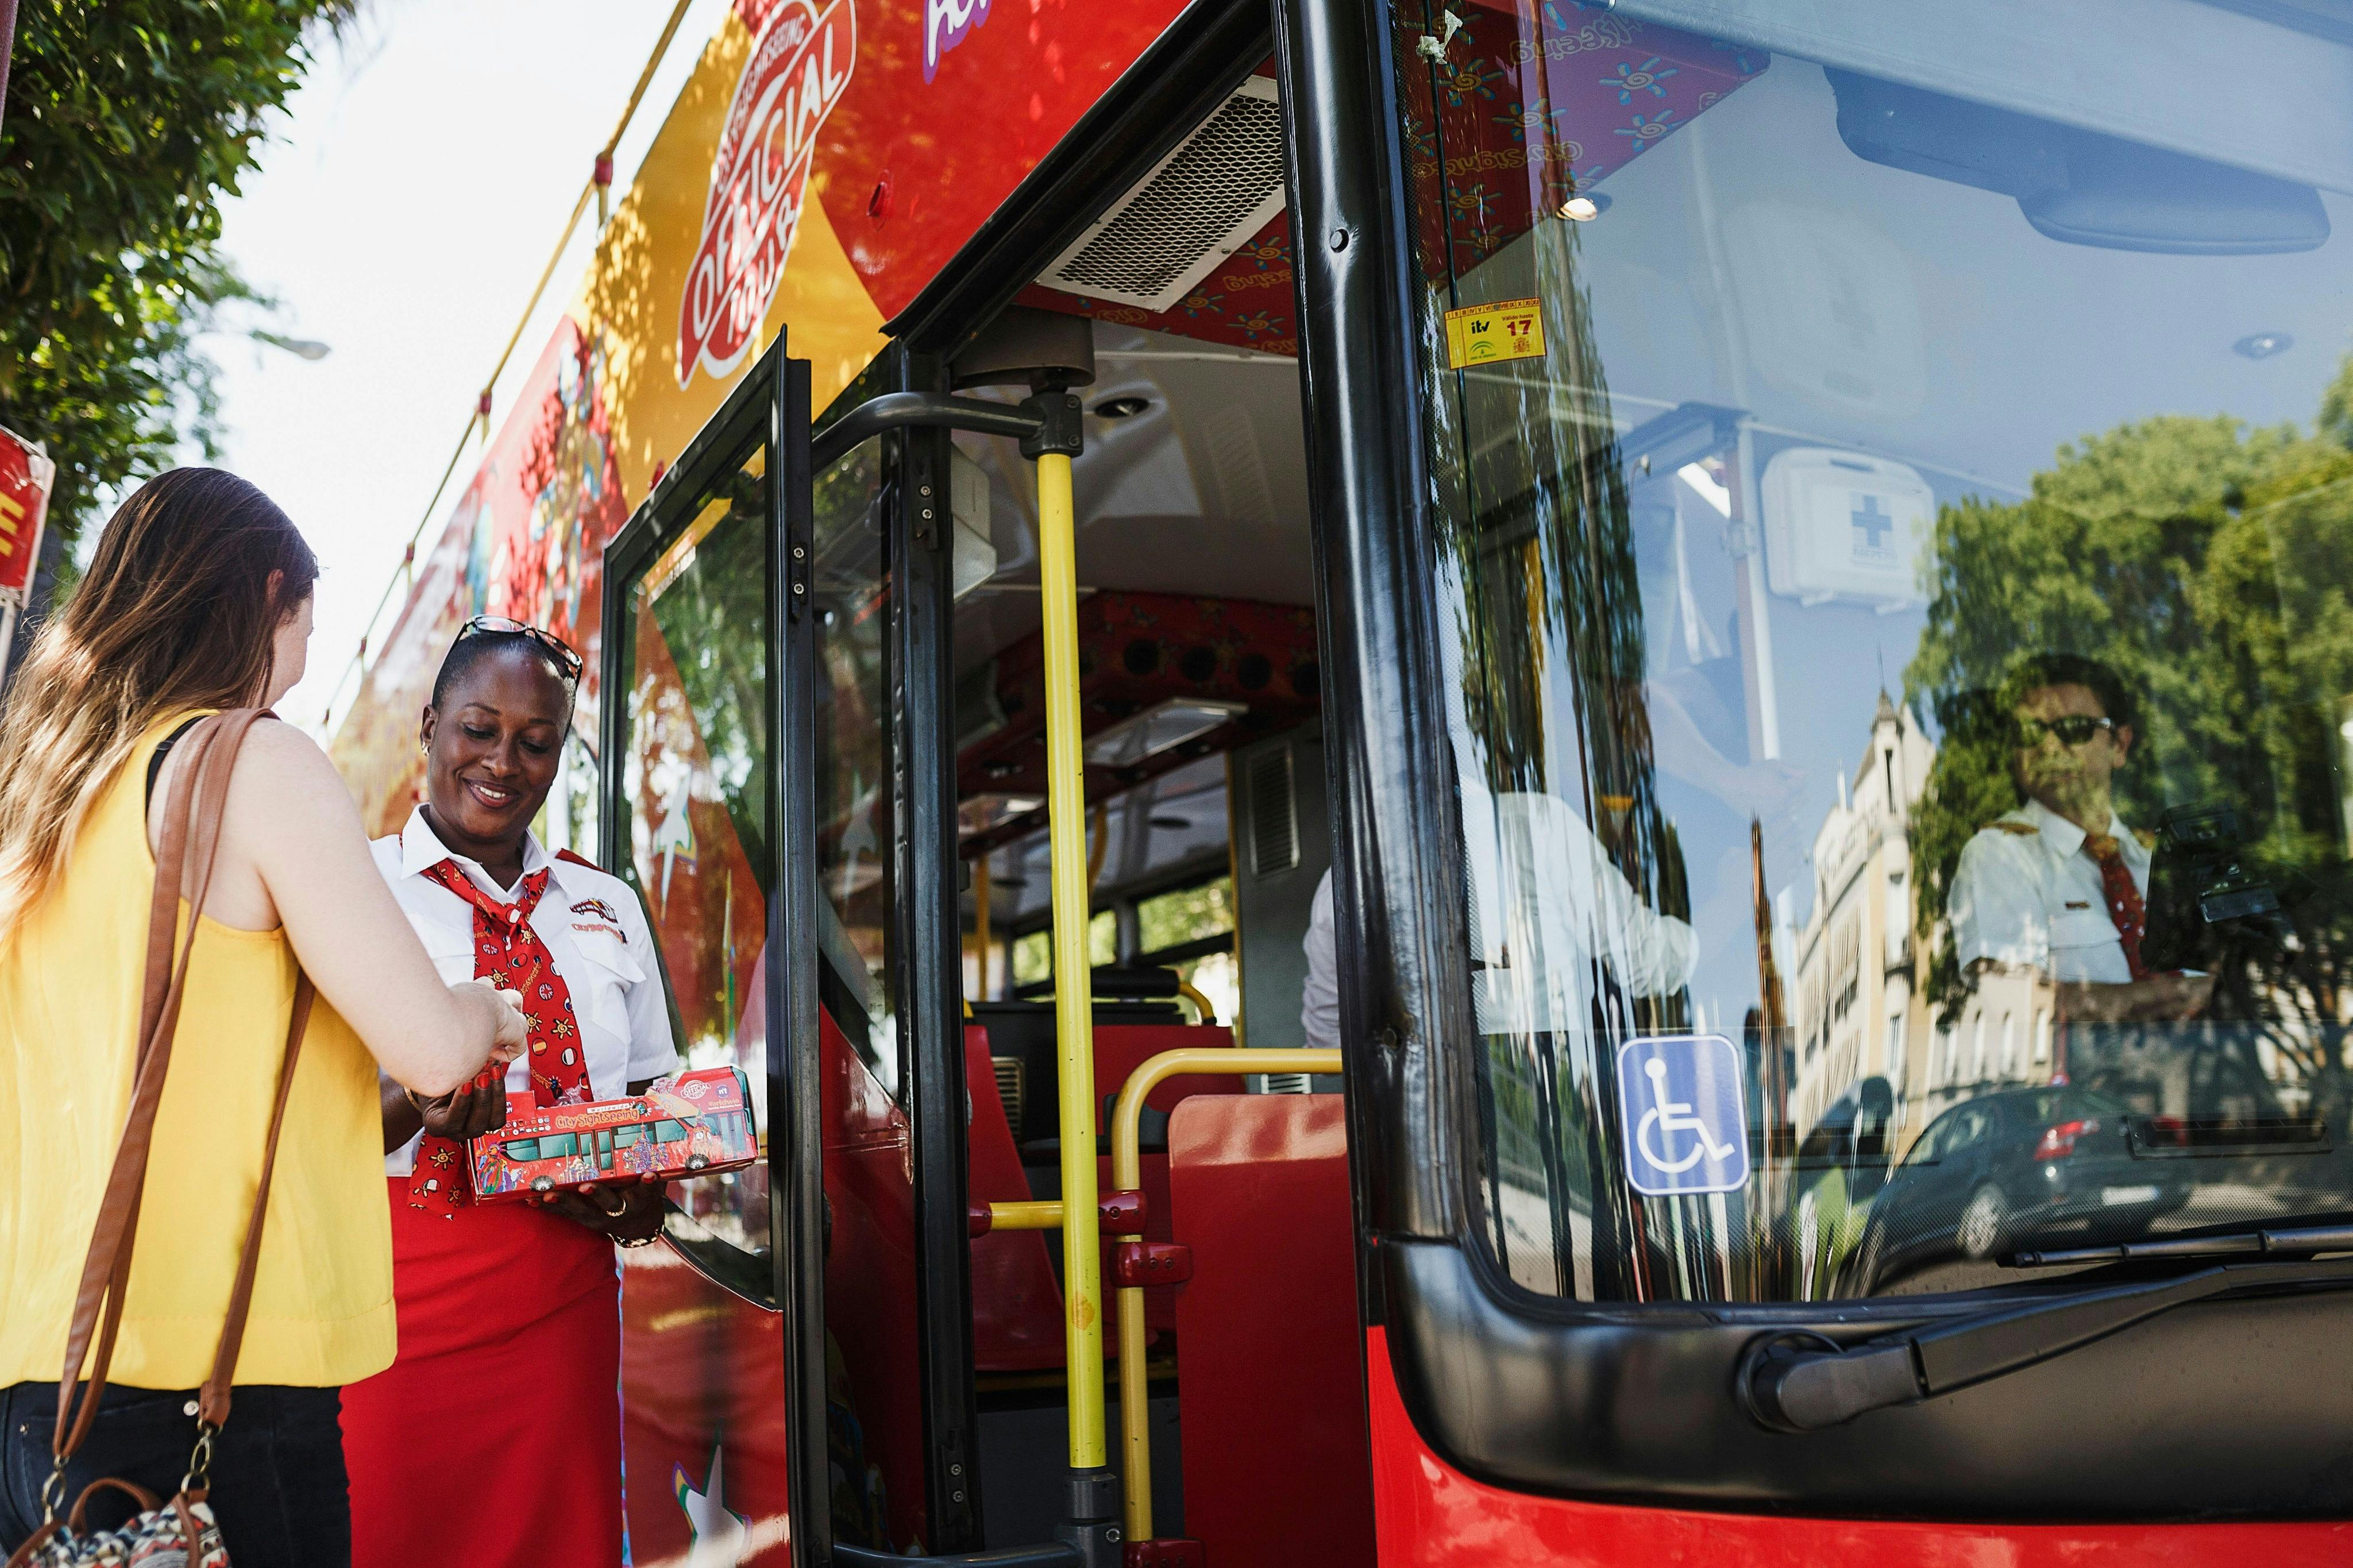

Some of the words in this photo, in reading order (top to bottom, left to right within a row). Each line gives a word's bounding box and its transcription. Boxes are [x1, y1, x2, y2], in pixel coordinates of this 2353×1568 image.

[693, 22, 843, 341] OFFICIAL
[727, 192, 796, 345] TOUR
[1471, 320, 1490, 334] itv
[1507, 320, 1532, 336] 17
[684, 1083, 711, 1096] OFFICIAL
